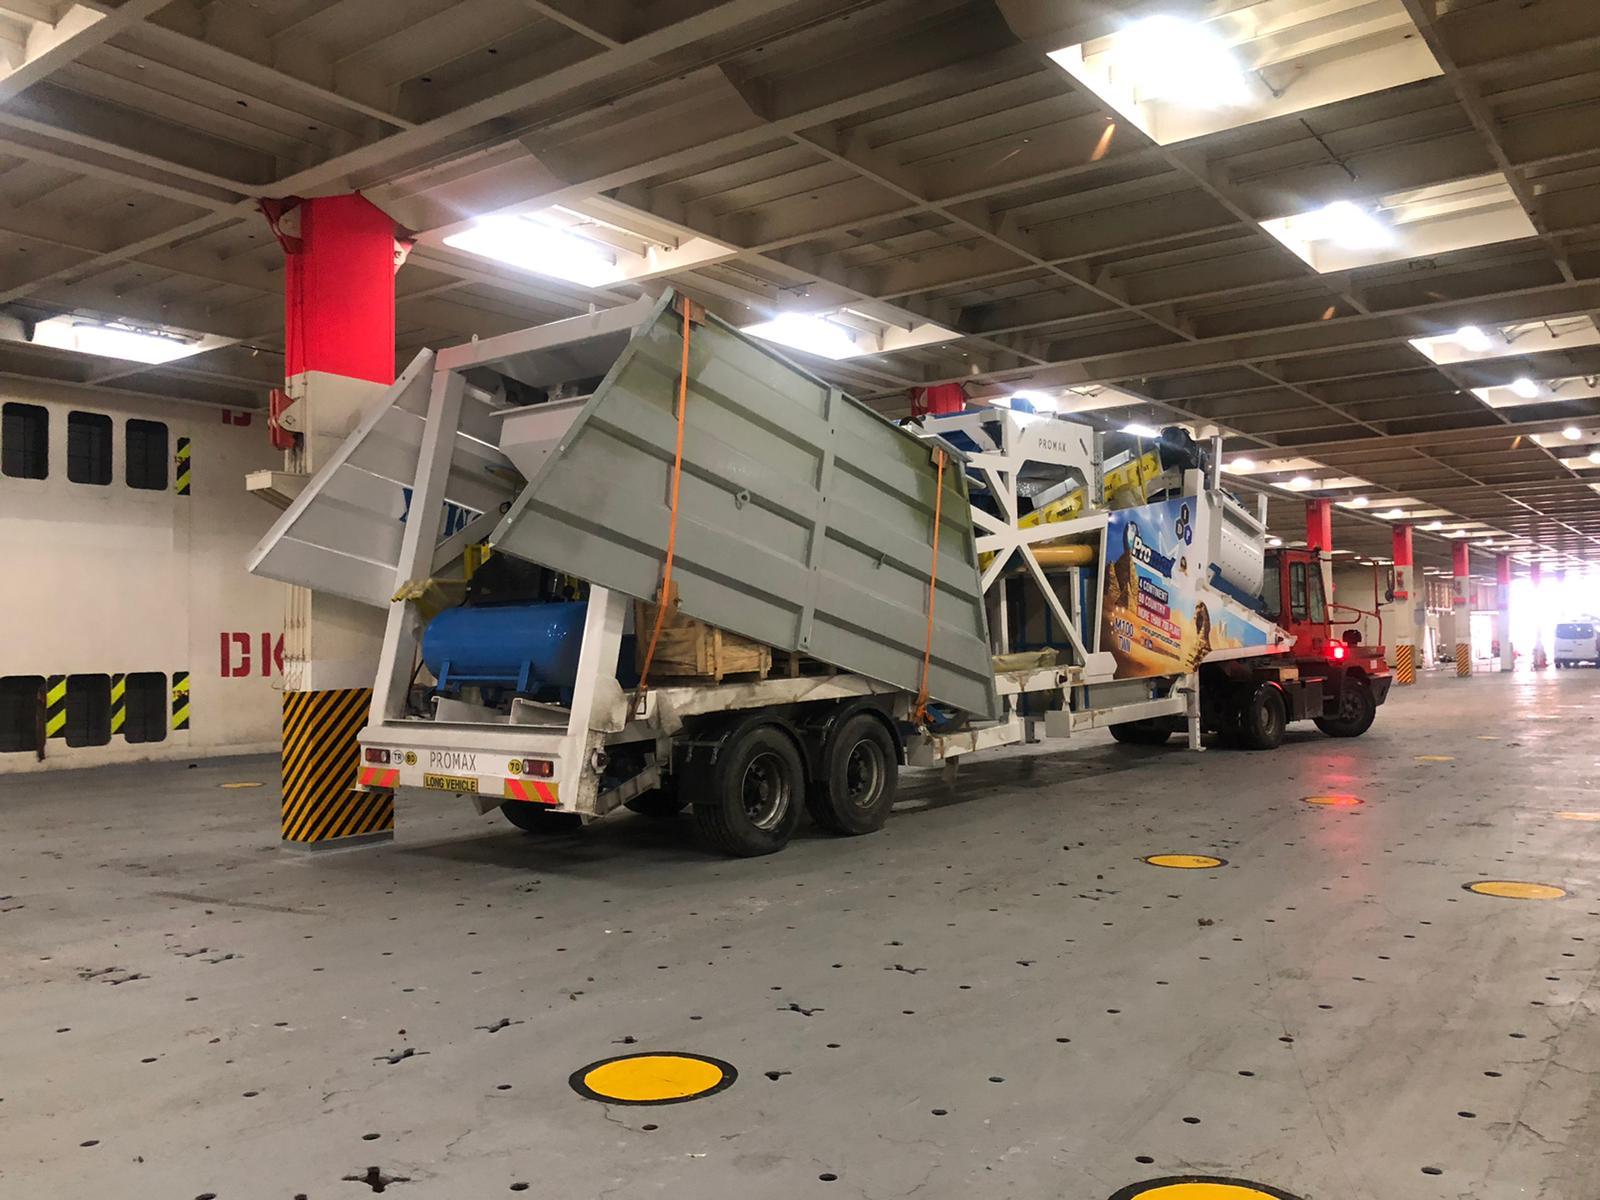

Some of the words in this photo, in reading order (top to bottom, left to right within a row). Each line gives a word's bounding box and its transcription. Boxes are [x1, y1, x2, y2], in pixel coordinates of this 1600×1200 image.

[1038, 438, 1066, 453] PROMAX
[430, 751, 476, 771] PROMAX
[510, 760, 521, 771] 70
[426, 775, 444, 789] LONG
[446, 777, 477, 793] VEHICLE
